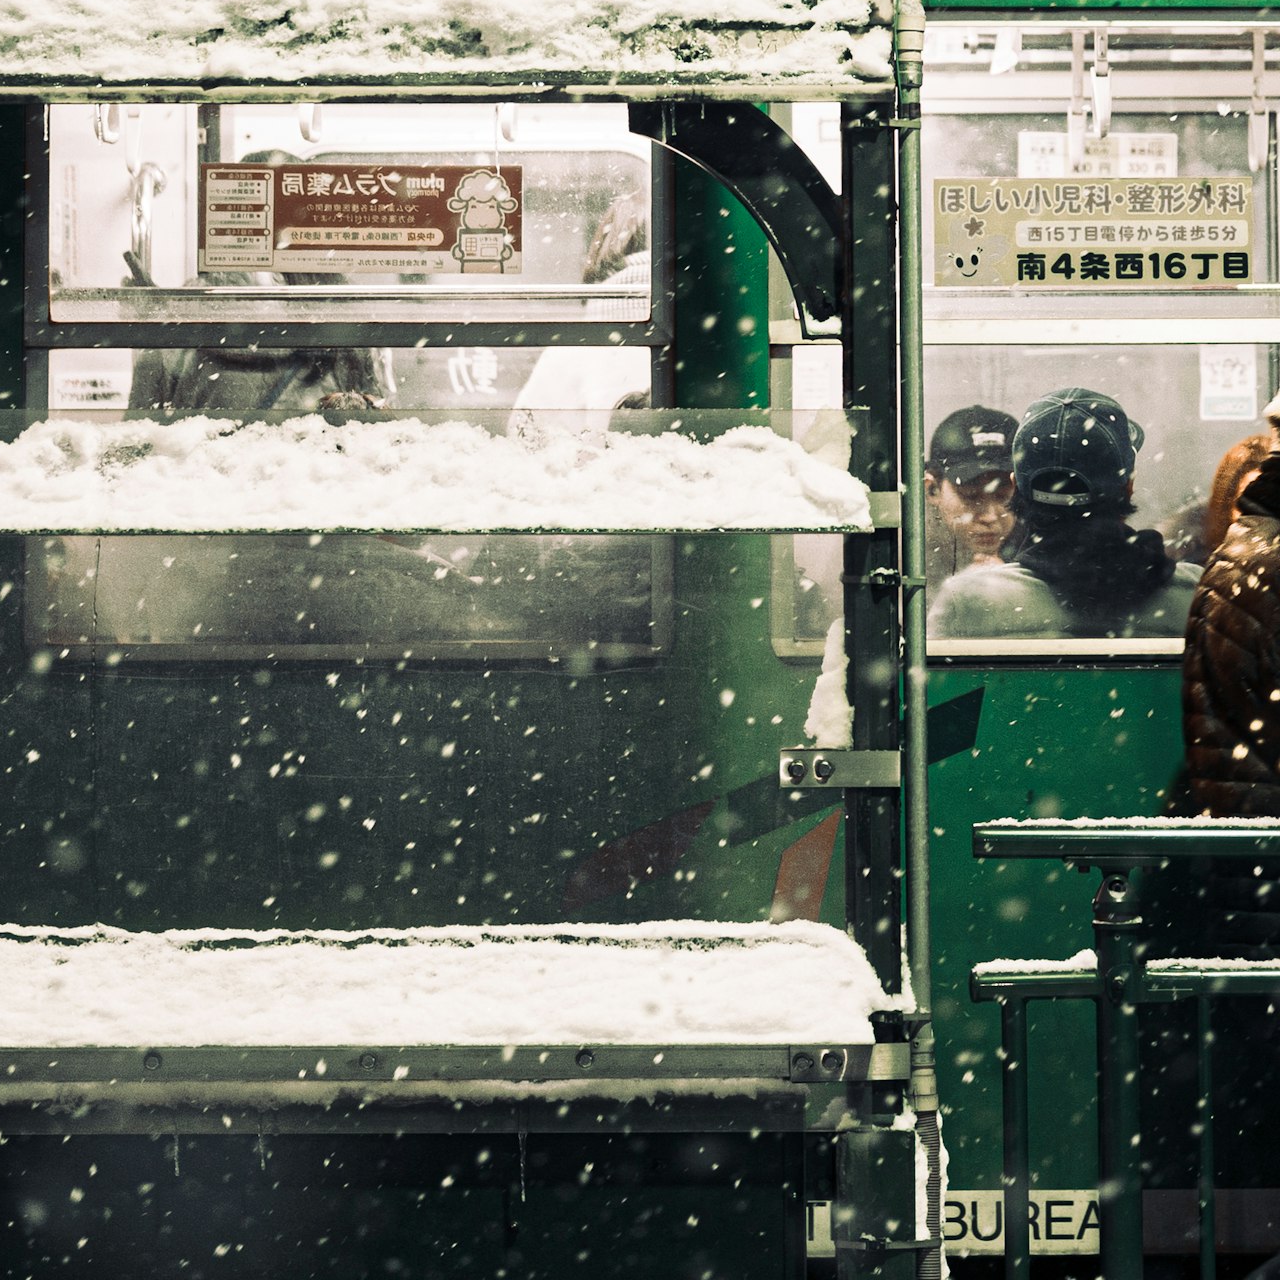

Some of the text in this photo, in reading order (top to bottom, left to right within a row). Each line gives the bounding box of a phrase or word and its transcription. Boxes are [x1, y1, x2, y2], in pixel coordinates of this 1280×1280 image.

[940, 183, 1247, 215] ほしい小児科・整形外科
[1027, 224, 1237, 243] 西15丁目電停から徒歩5分
[1016, 251, 1250, 281] 南4条西16丁目
